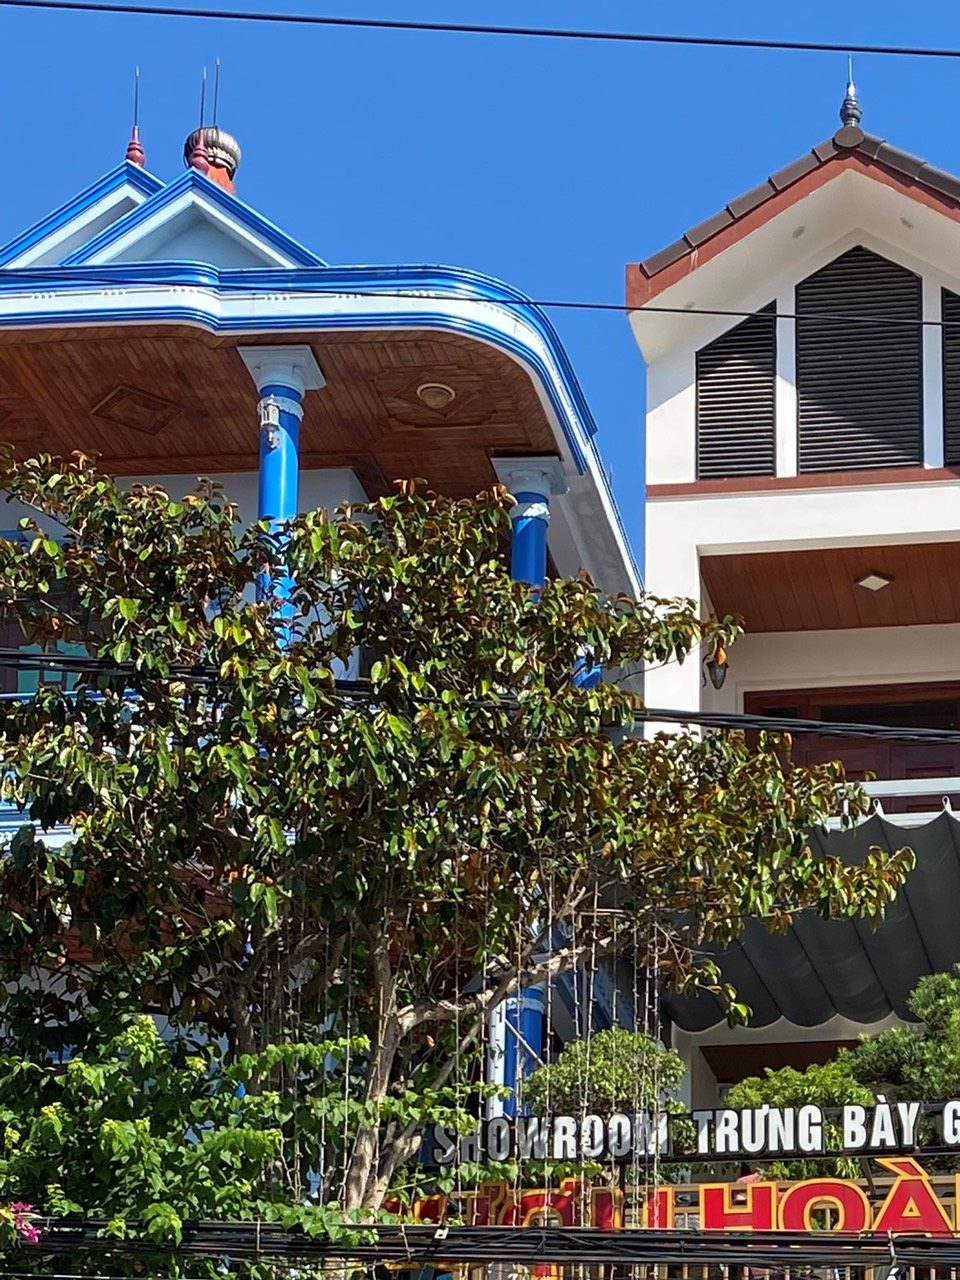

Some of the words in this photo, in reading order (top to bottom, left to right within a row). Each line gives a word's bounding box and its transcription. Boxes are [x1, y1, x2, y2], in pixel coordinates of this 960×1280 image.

[433, 1112, 671, 1164] SHOWROOM
[693, 1101, 824, 1154] TRƯNG
[844, 1093, 920, 1149] BÀY
